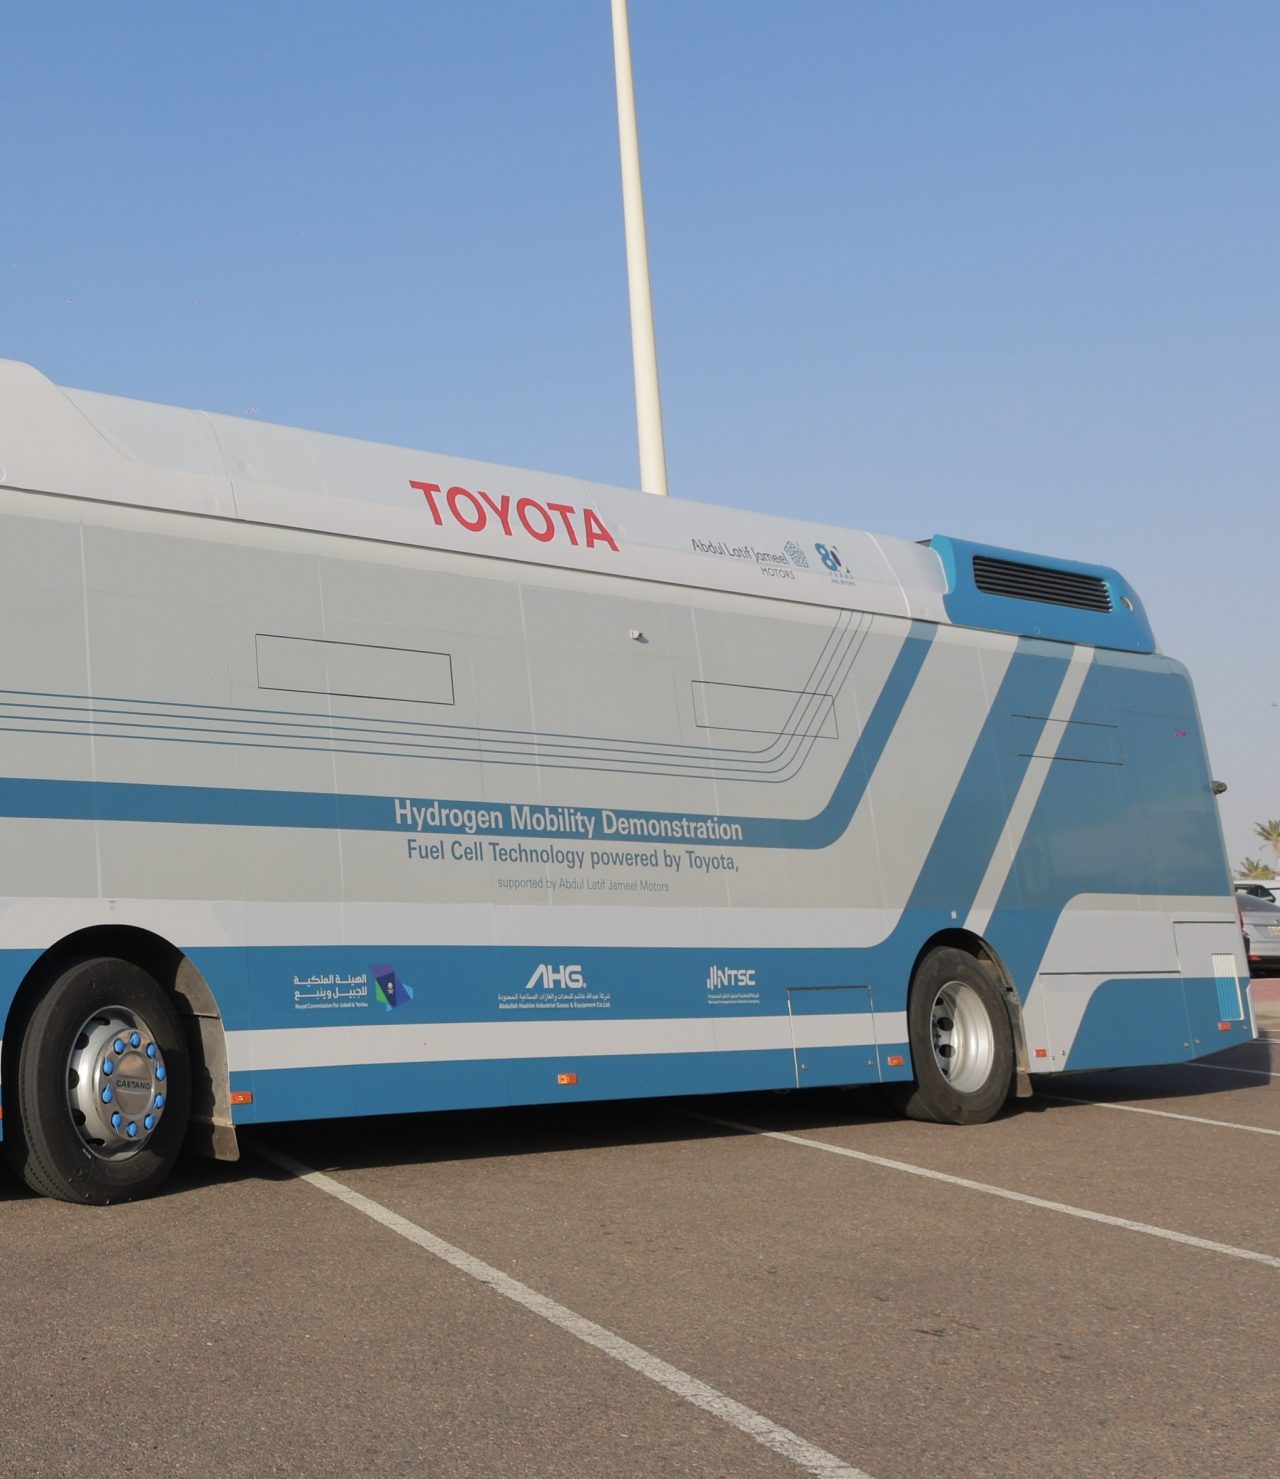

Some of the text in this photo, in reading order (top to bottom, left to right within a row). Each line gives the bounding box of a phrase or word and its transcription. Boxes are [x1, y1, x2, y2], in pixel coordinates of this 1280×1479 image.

[408, 480, 620, 552] TOYOTA
[691, 538, 790, 564] Abdul Latif Jameel
[760, 566, 795, 580] MOTORS
[394, 799, 743, 841] Hydrogen Mobility Demonstration
[407, 839, 740, 873] Fuel Cell Technology powered by Toyota,
[497, 878, 669, 892] supported by Abdul Latif Jameel Motors
[293, 975, 334, 987] الملكية
[333, 987, 368, 999] للجبيل
[116, 1080, 152, 1090] CAETANO
